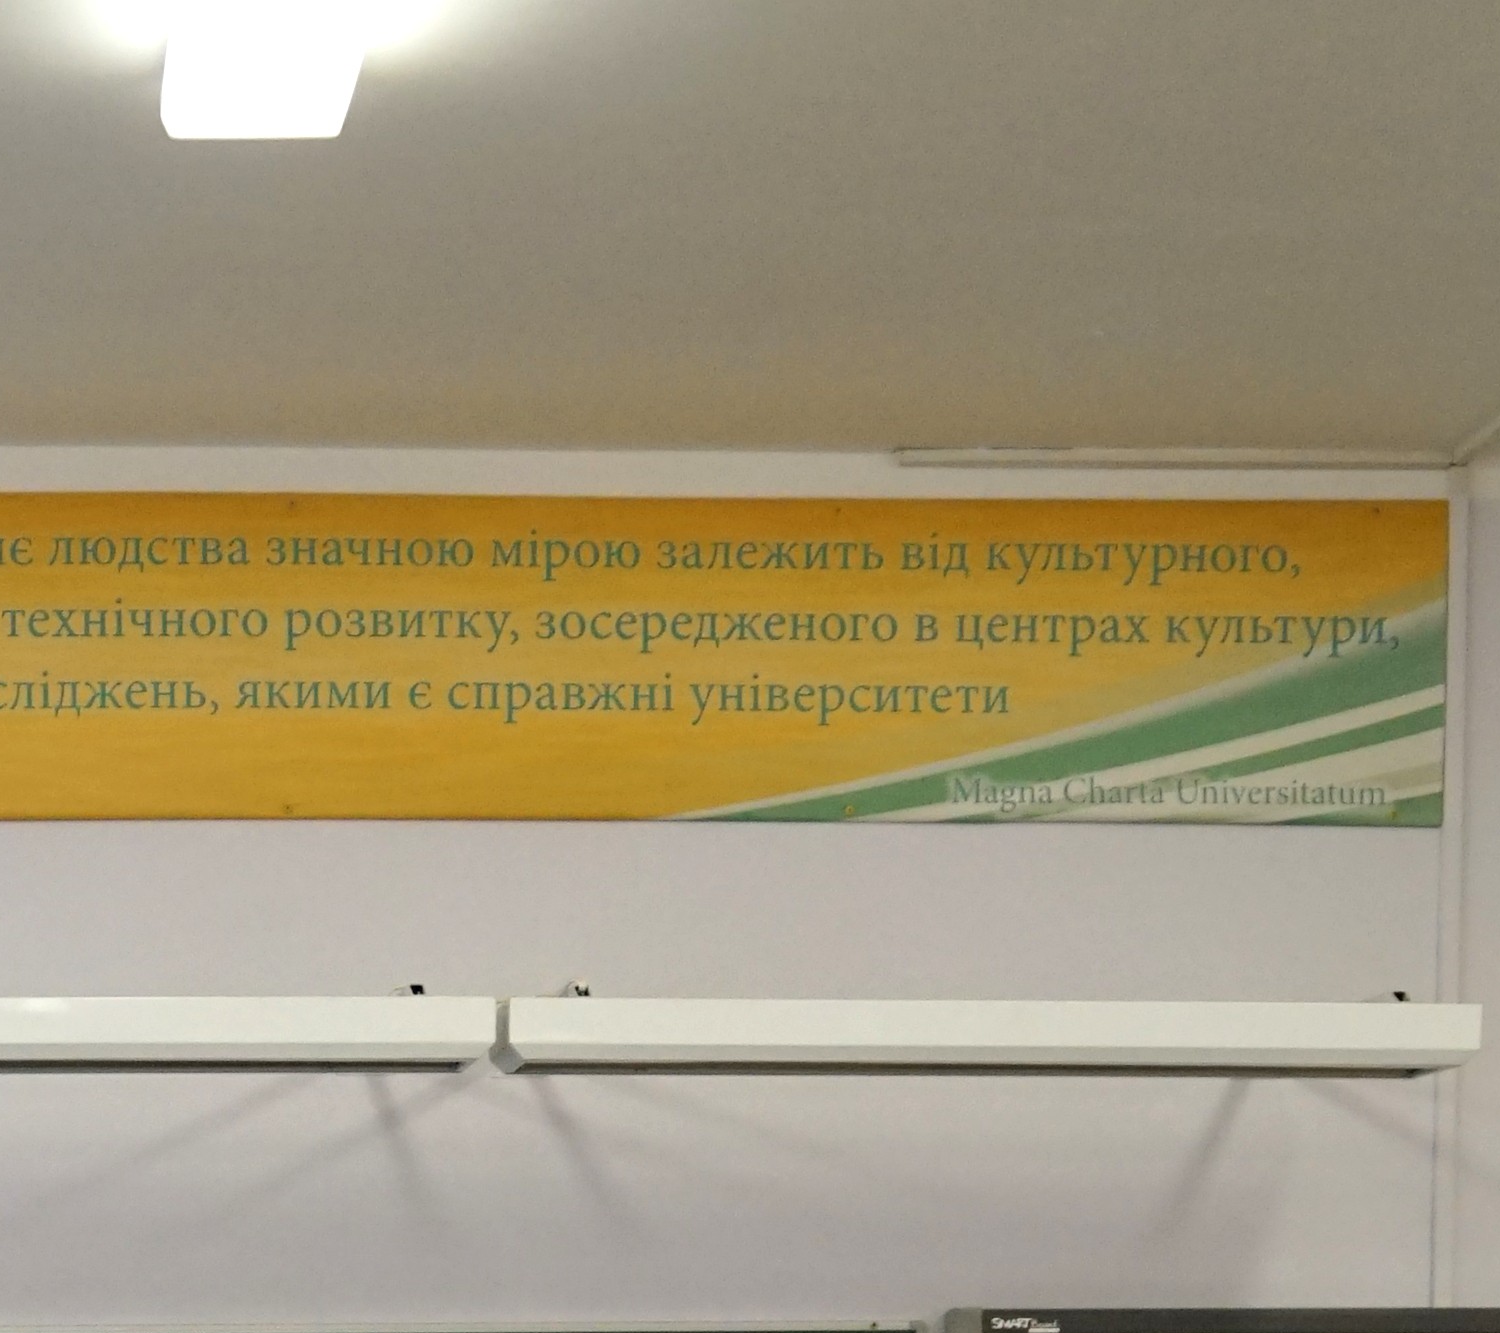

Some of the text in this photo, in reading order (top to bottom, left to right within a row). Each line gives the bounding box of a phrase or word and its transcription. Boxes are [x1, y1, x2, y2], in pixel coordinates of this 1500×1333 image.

[49, 534, 249, 573] людства
[266, 536, 475, 568] значною
[491, 528, 641, 581] мірою
[657, 538, 884, 570] залежить
[900, 532, 970, 578] від
[985, 538, 1302, 585] культурного,
[2, 599, 268, 640] технічного
[284, 607, 519, 653] розвитку,
[535, 609, 898, 654] зосередженого
[915, 614, 939, 642] в
[956, 611, 1150, 657] центрах
[1165, 612, 1400, 657] культури,
[235, 680, 390, 710] якими
[409, 679, 431, 710] є
[447, 672, 673, 724] справжні
[691, 673, 1010, 725] університети
[949, 776, 1387, 813] Magna Charta Universitatum
[991, 1317, 1032, 1329] SMART
